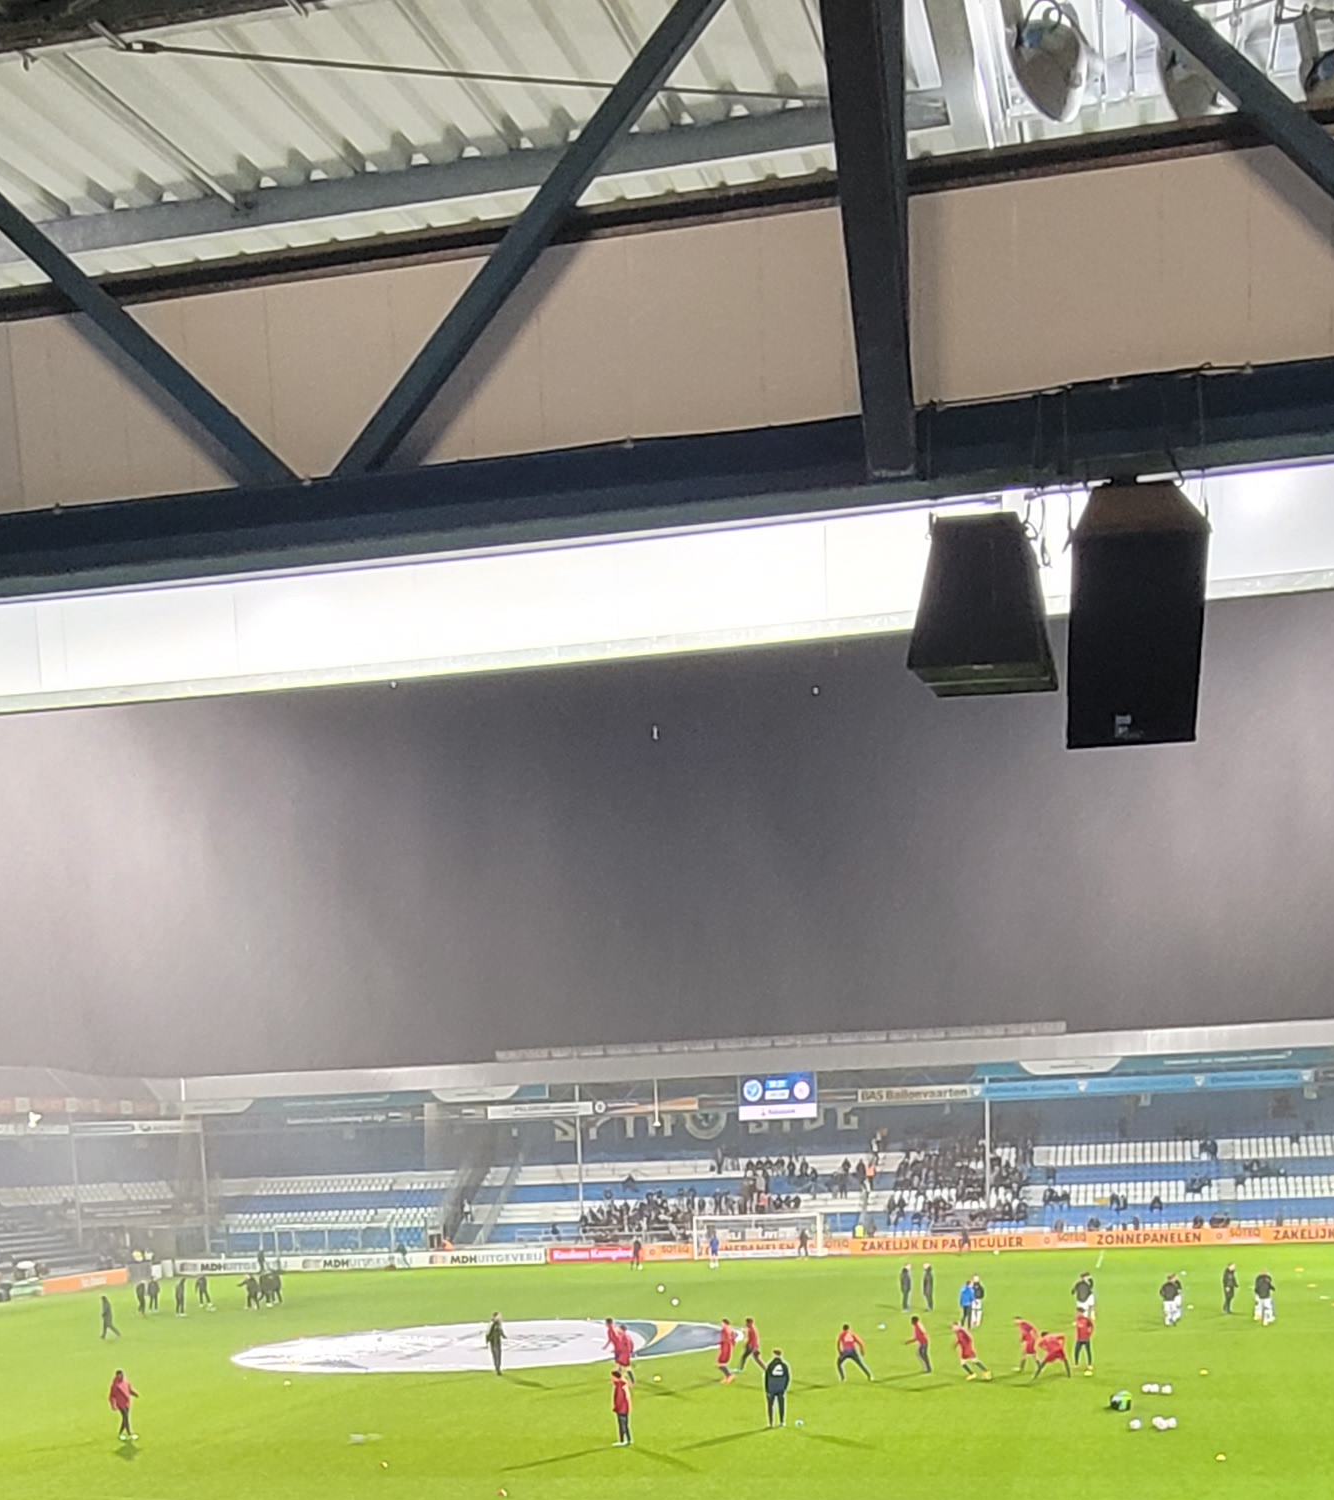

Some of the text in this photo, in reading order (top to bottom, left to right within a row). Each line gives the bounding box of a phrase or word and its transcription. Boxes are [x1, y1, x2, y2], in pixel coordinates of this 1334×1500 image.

[885, 1086, 968, 1100] Ballonvaarten
[861, 1239, 918, 1251] ZAKELIJK
[922, 1239, 939, 1250] EN
[1096, 1231, 1202, 1245] ZONNEPANELEN
